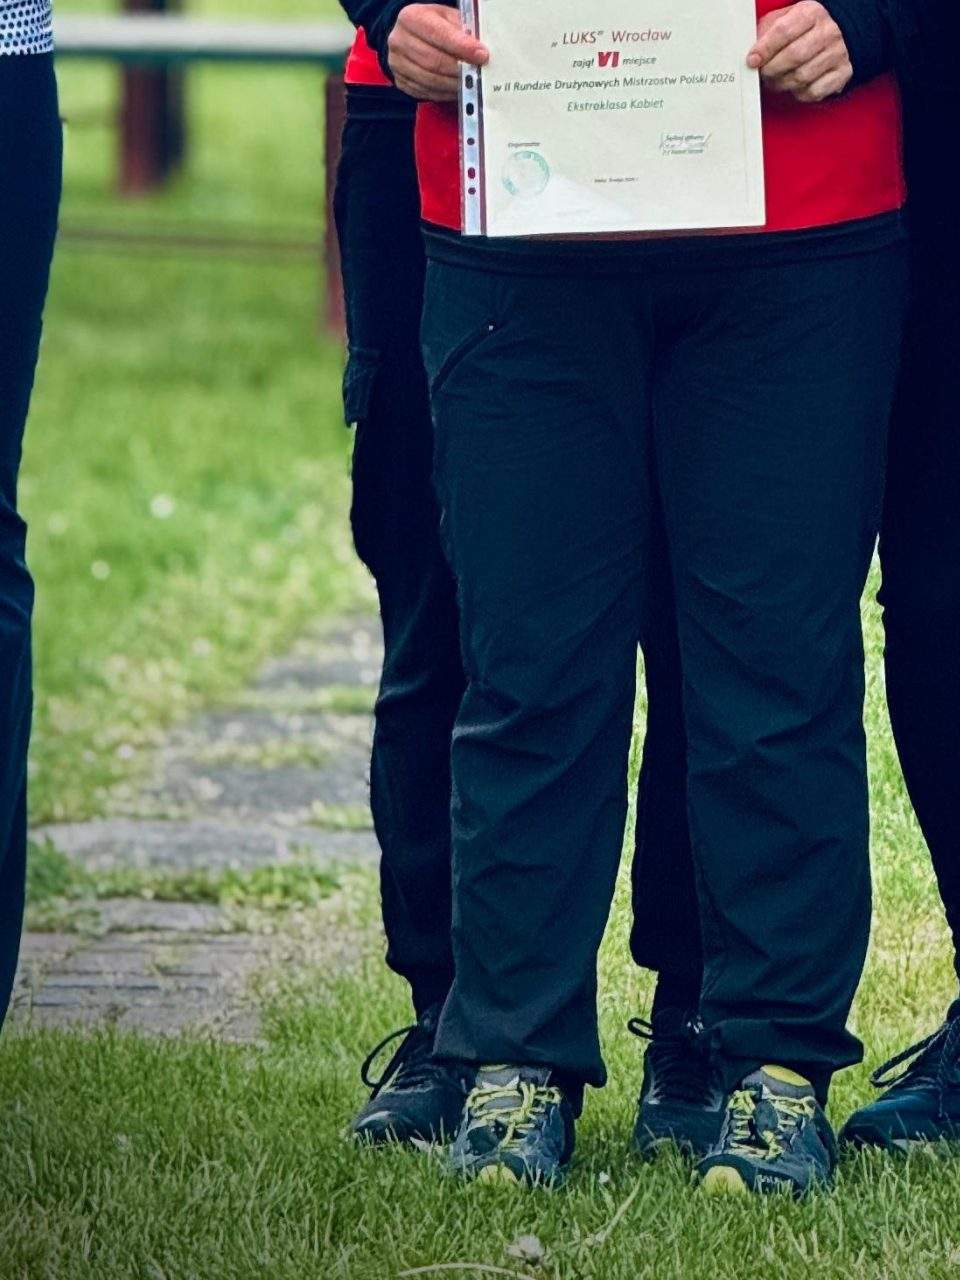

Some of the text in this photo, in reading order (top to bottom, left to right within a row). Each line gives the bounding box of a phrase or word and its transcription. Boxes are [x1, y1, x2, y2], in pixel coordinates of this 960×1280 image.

[598, 51, 620, 68] VI
[493, 84, 502, 92] w
[513, 81, 552, 92] Rundzie
[622, 76, 677, 88] Mistrzostw
[679, 75, 708, 85] Polski
[567, 98, 664, 112] Ekstraklasa Kobiet
